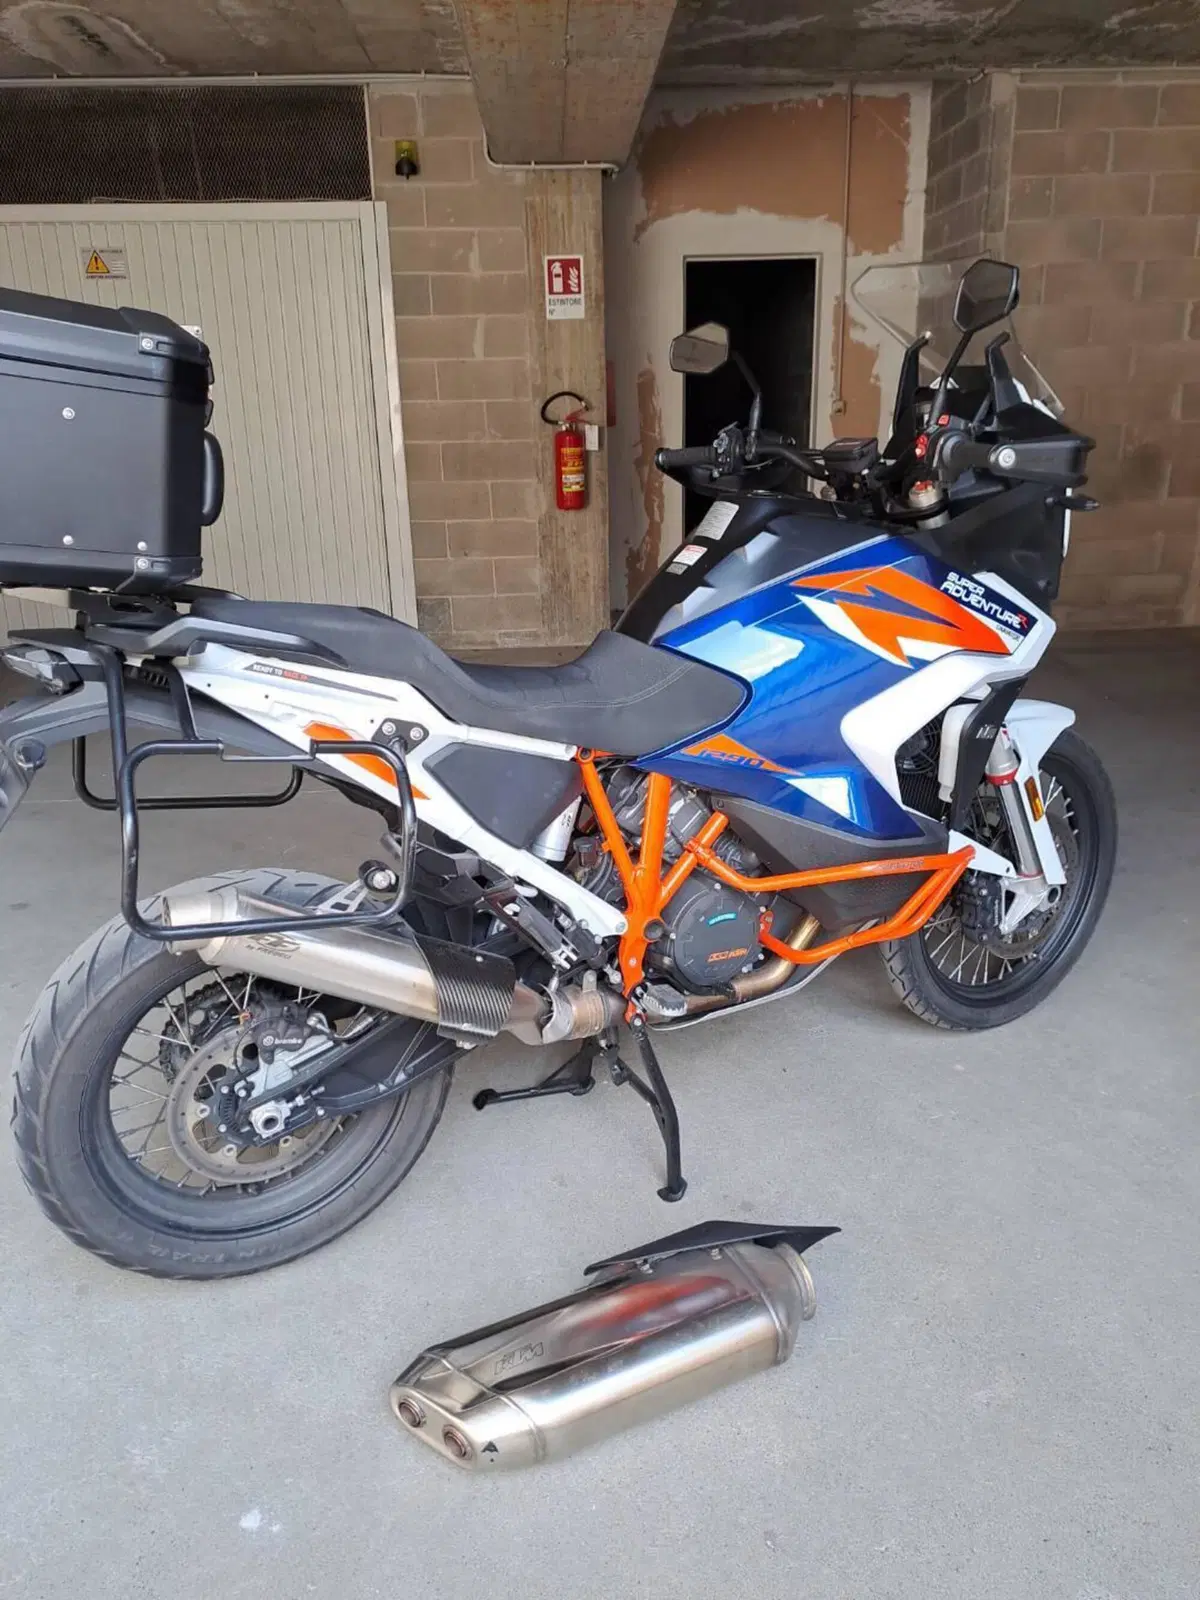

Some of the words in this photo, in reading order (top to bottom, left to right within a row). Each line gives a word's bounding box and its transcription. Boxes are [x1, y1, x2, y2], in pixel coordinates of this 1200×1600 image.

[548, 298, 582, 306] ESTINTORE
[946, 571, 985, 596] SUPER
[940, 581, 1021, 629] ADVENTURE
[252, 664, 273, 674] READY
[274, 668, 283, 677] TO
[700, 748, 764, 769] 1290
[274, 1037, 303, 1045] brembo
[494, 1341, 545, 1376] KTM
